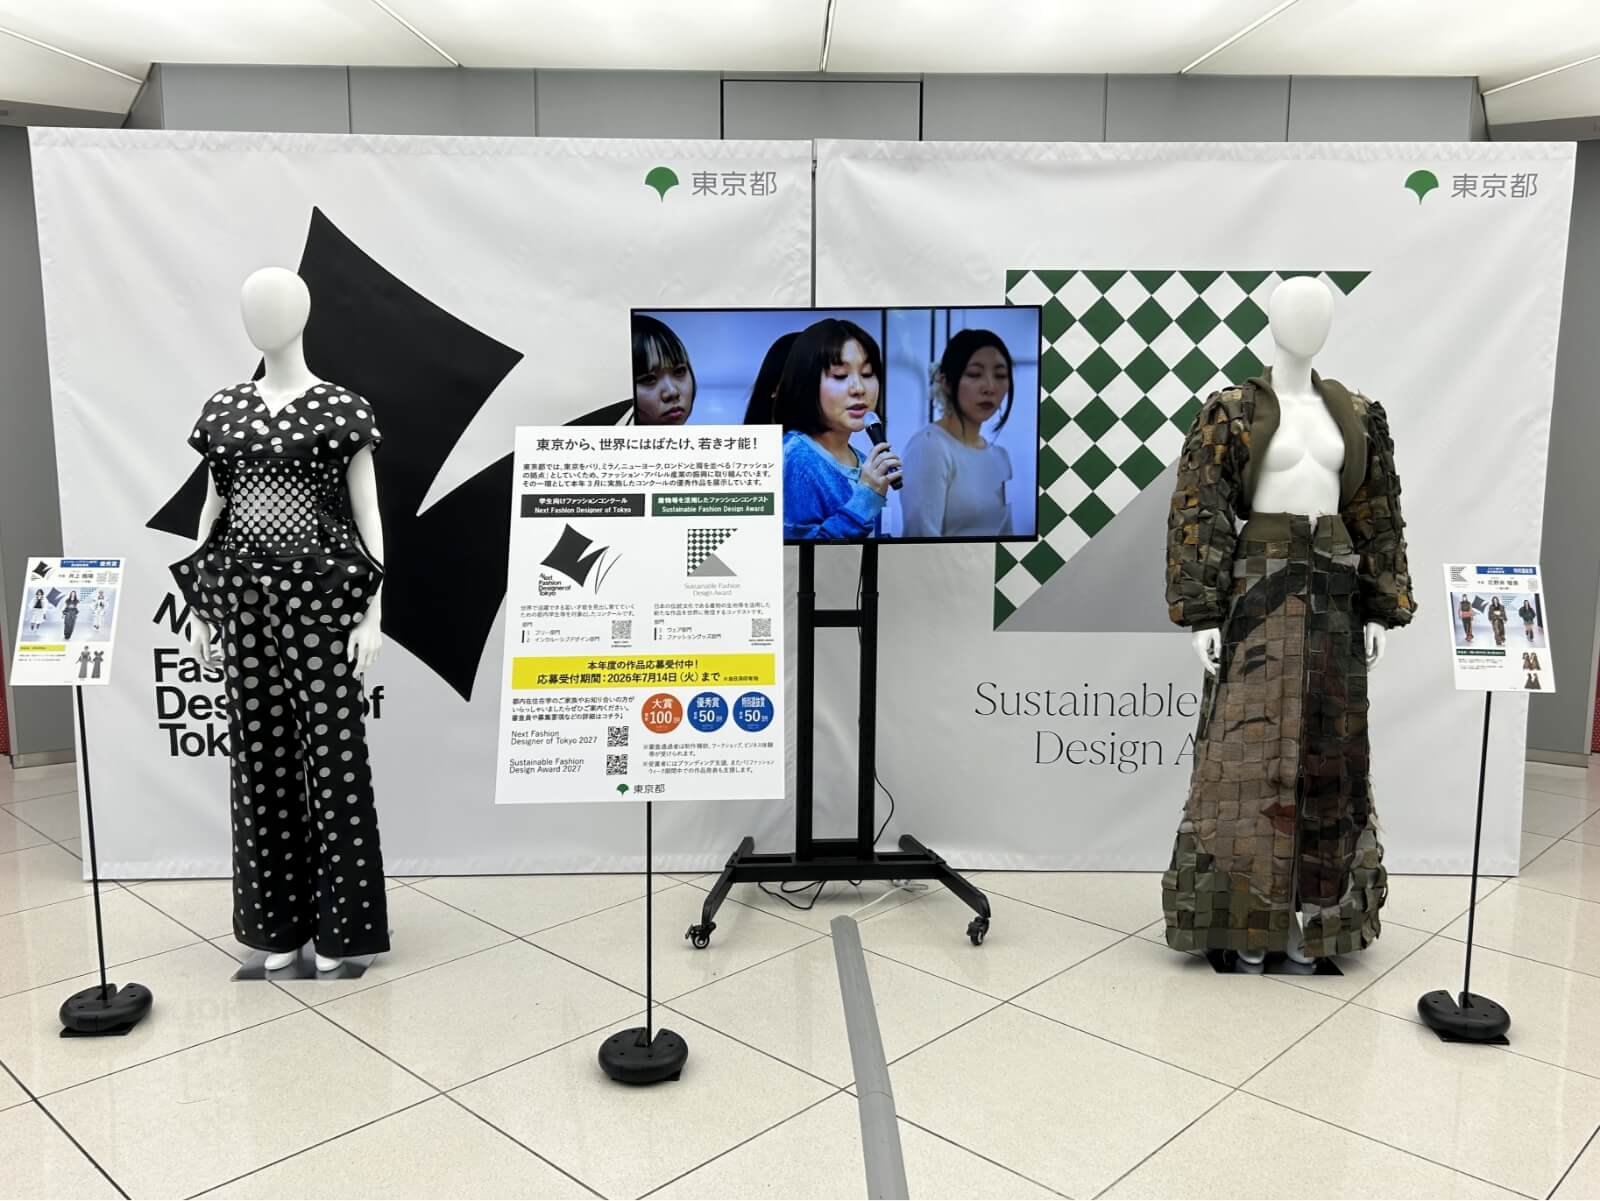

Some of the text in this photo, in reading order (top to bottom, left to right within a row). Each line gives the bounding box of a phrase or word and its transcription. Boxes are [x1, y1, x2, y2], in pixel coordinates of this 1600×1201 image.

[691, 171, 778, 196] 東京都
[1450, 173, 1538, 198] 東京都
[362, 685, 384, 719] f
[652, 698, 673, 709] 大賞
[974, 681, 1198, 718] Sustainable
[650, 710, 673, 724] 100
[699, 710, 715, 722] 50
[744, 709, 760, 722] 50
[158, 723, 230, 757] Tok
[511, 738, 544, 746] Designer
[556, 737, 578, 746] Tokyo
[578, 736, 598, 744] 2027
[1035, 730, 1163, 774] Design
[509, 758, 553, 766] Sustainable
[509, 766, 536, 774] Design
[537, 766, 560, 774] Award
[634, 784, 666, 794] 東京都
